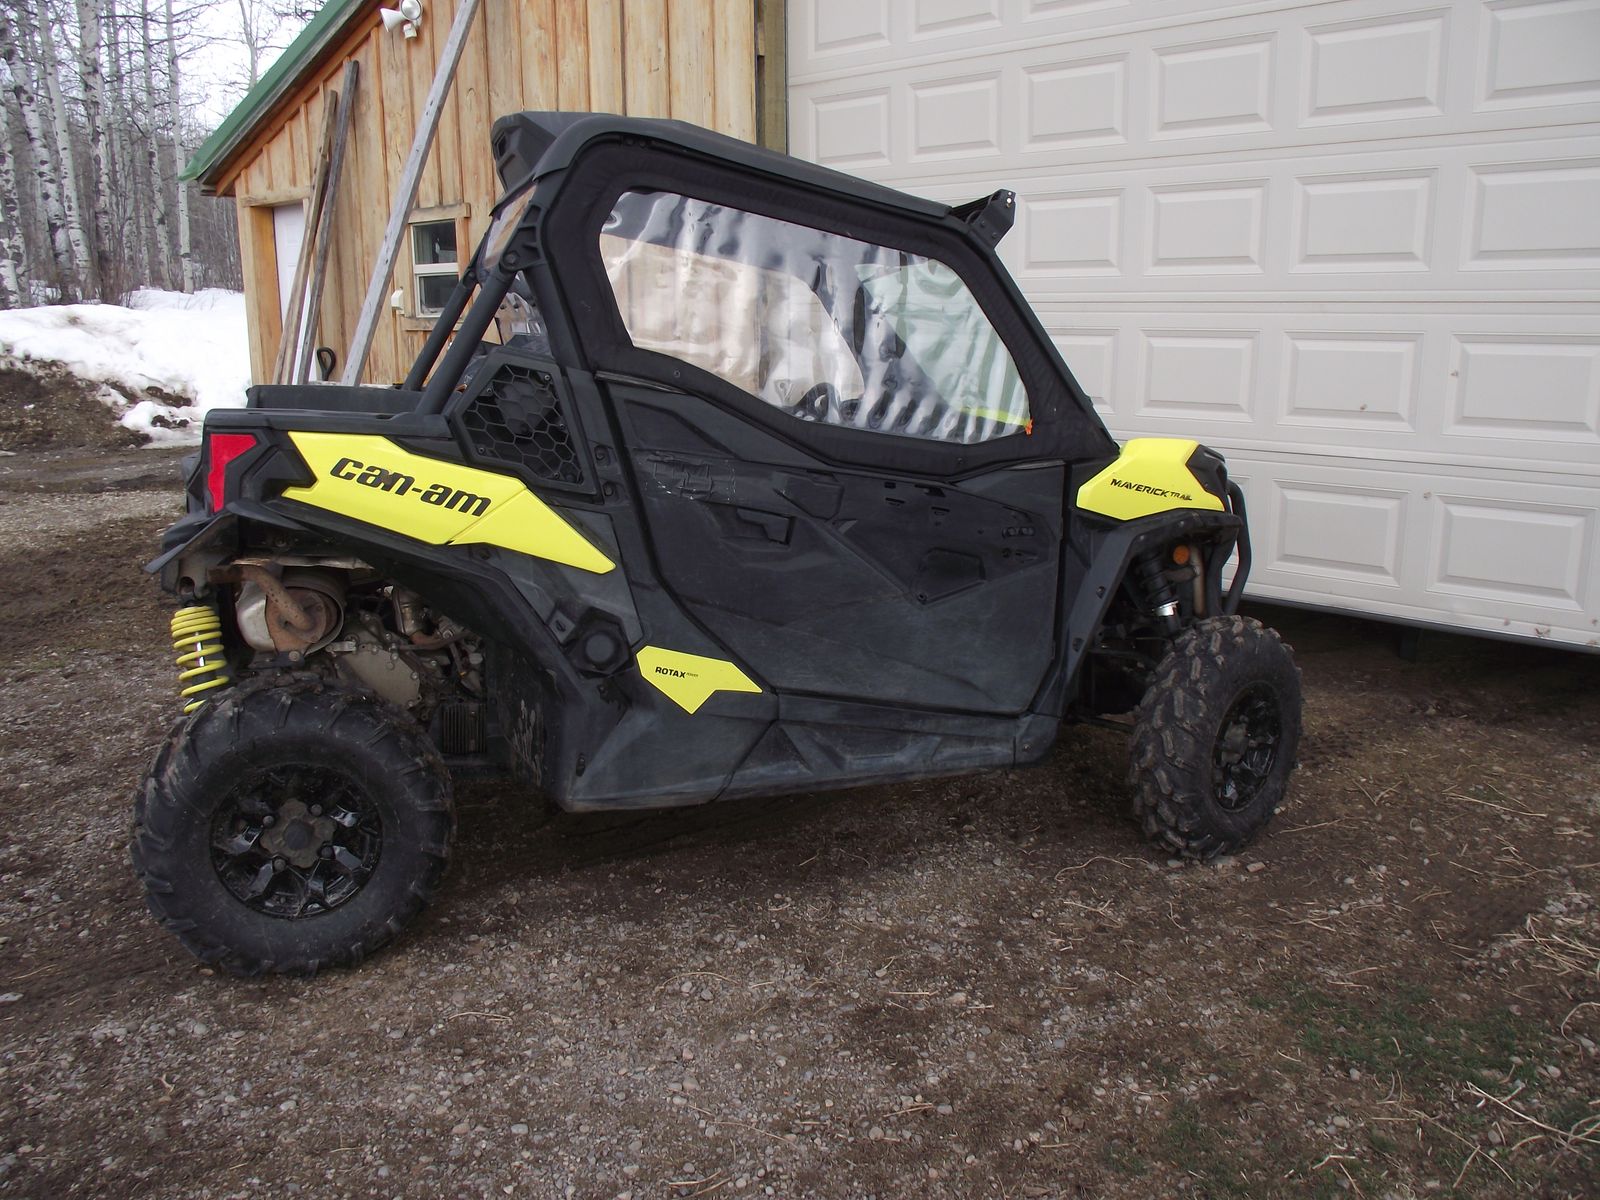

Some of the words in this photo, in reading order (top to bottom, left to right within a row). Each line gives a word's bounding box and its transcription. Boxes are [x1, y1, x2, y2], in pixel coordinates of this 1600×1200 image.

[1110, 478, 1169, 498] MAVERICK
[1170, 491, 1193, 501] TRAIL
[655, 666, 686, 678] ROTAX
